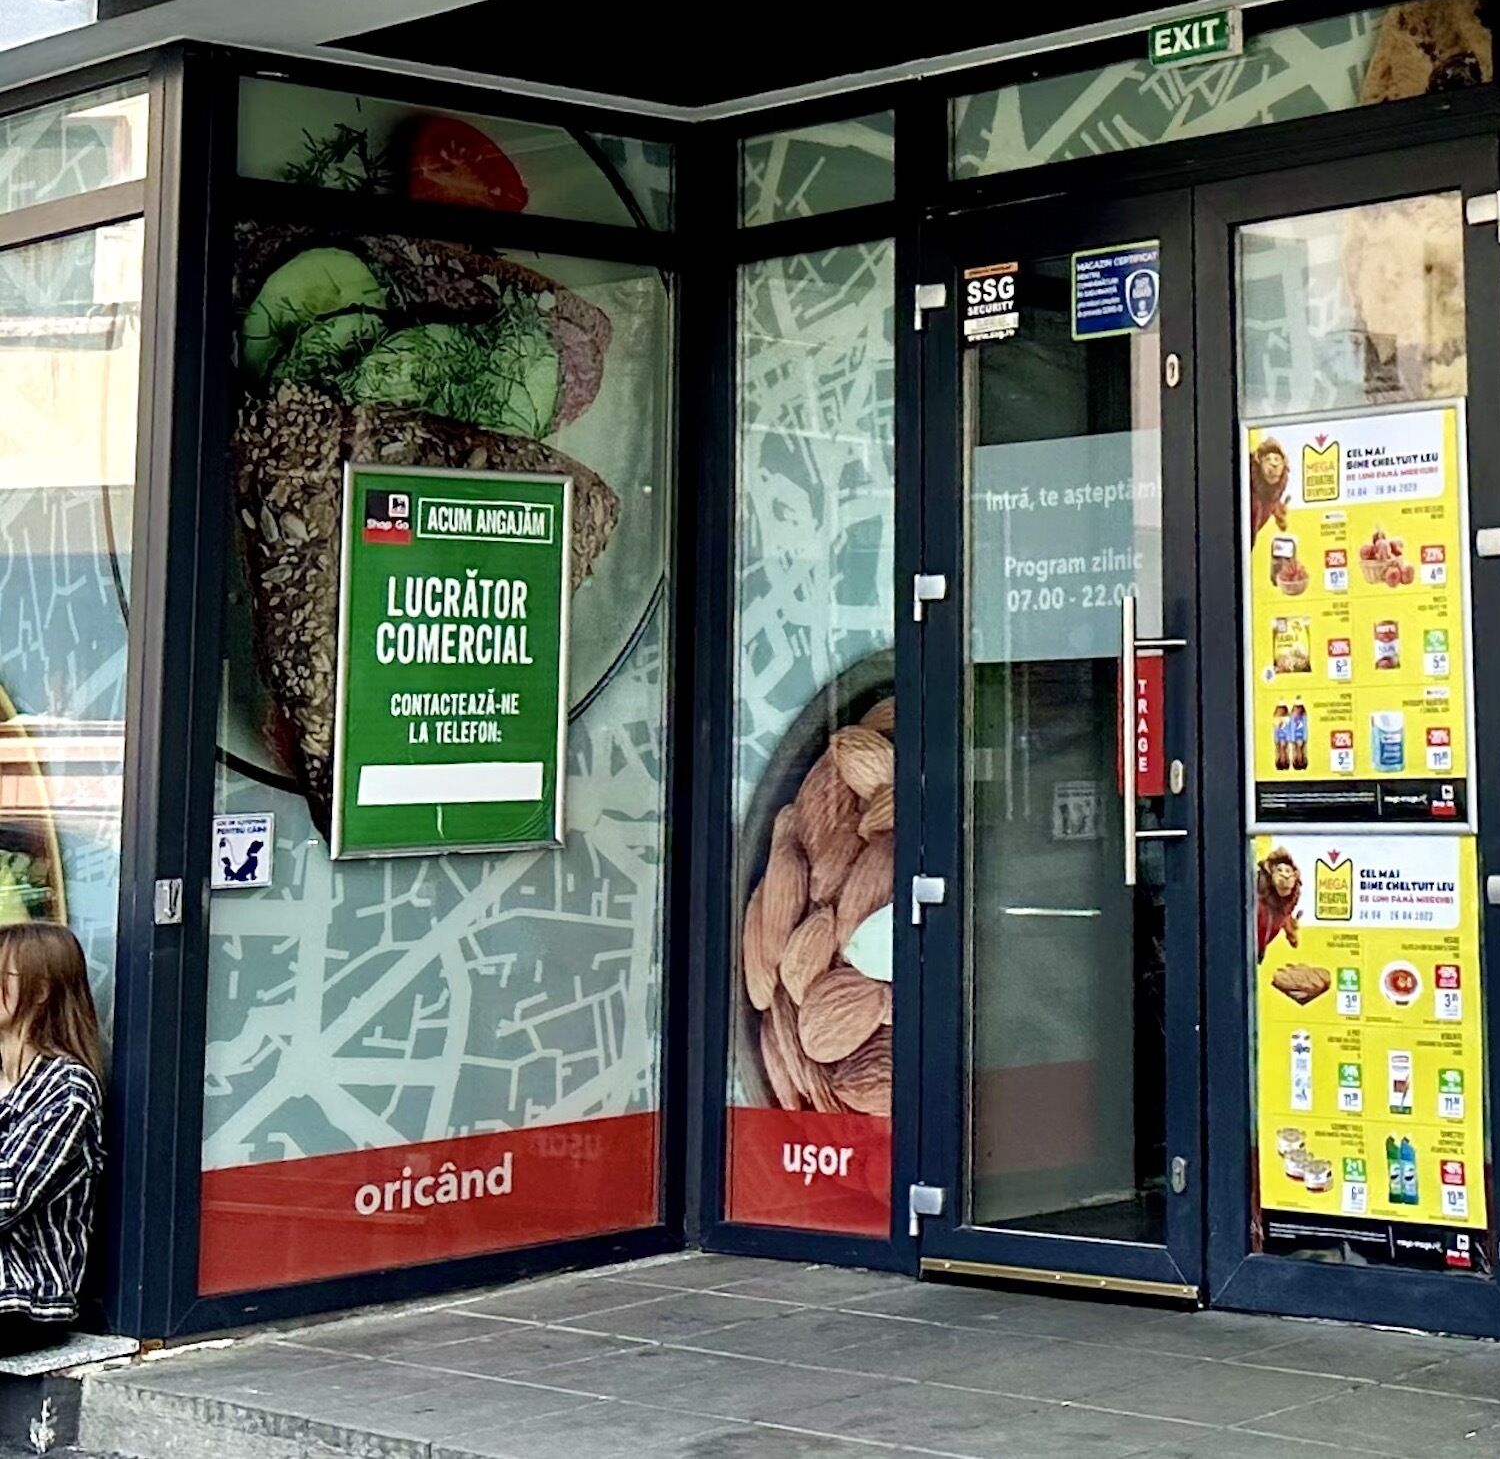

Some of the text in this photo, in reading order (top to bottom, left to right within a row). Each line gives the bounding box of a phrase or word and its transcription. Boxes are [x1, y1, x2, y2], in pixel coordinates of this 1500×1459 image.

[1155, 18, 1220, 57] EXIT
[967, 275, 1015, 304] SSG
[967, 300, 1014, 316] SECURITY
[1040, 487, 1058, 506] te
[427, 503, 546, 536] ACUM ANGAJĂM
[1004, 547, 1144, 582] Program zilnic
[387, 568, 528, 620] LUCRĂTOR
[1007, 587, 1065, 613] 07.00
[376, 622, 533, 665] COMERCIAL
[390, 688, 520, 717] CONTACTEAZĂ-NE
[409, 720, 503, 744] LA TELEFON:
[1137, 679, 1149, 773] TRAGE
[783, 1140, 854, 1187] ușor
[354, 1152, 514, 1215] oricând
